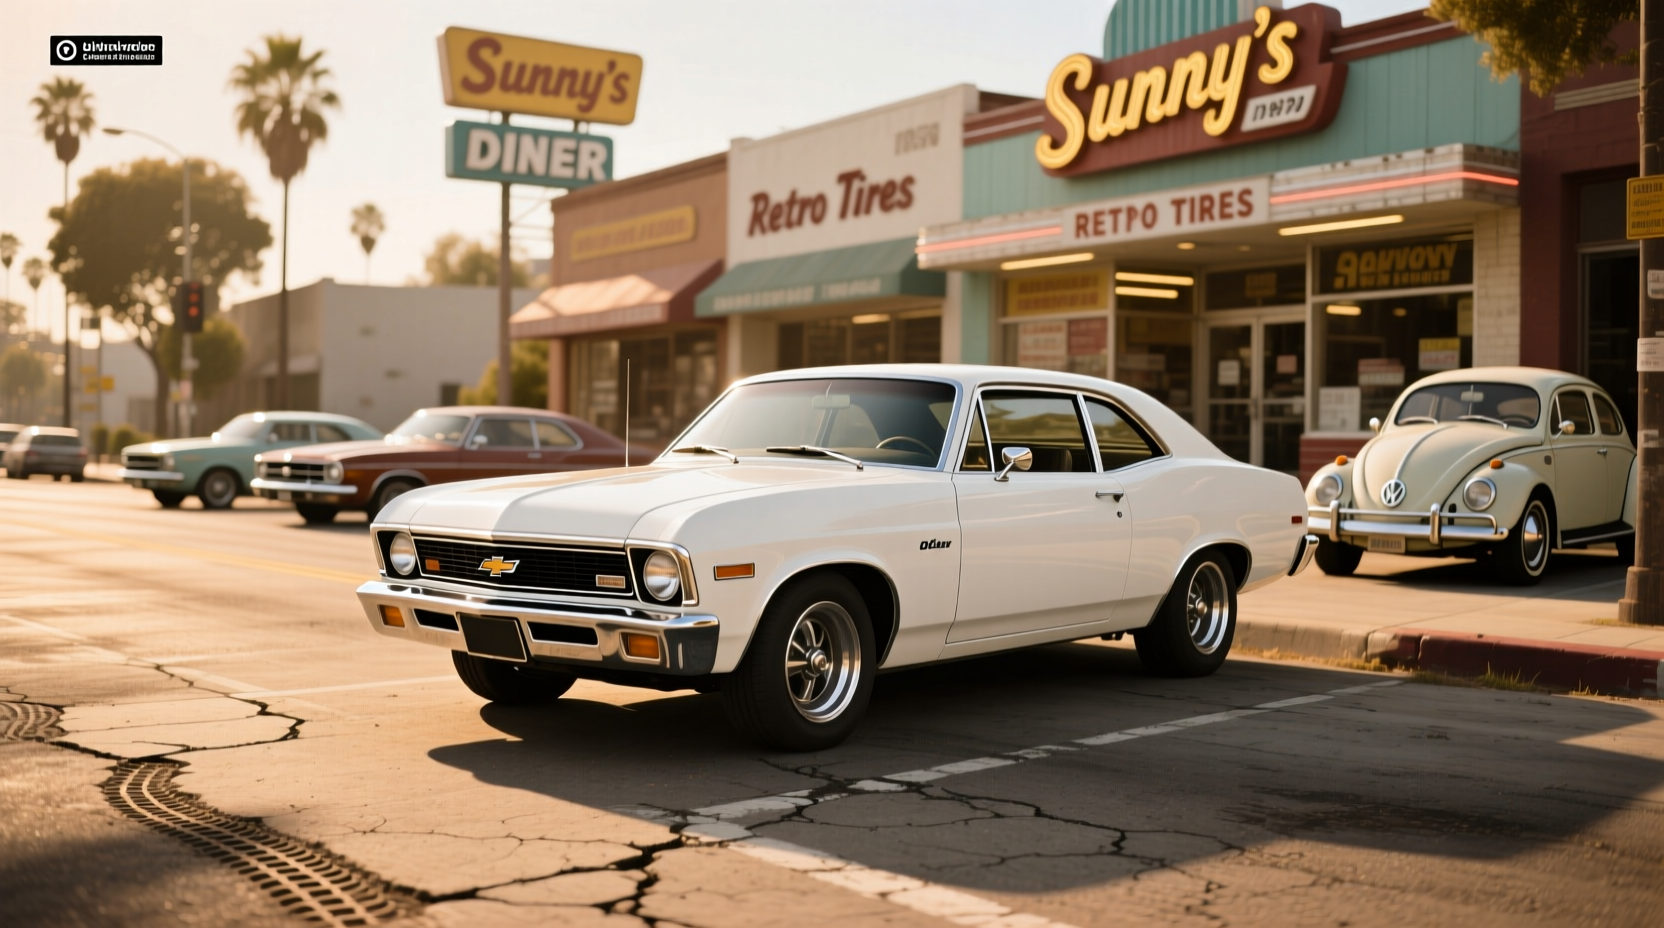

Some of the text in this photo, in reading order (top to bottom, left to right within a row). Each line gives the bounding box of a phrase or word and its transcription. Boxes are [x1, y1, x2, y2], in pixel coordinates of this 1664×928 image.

[461, 36, 630, 113] Sunny's
[1035, 6, 1297, 169] Sunny's
[465, 128, 607, 181] DINER
[747, 188, 827, 237] Retro
[837, 169, 915, 220] Tires
[1170, 188, 1254, 226] TIRES
